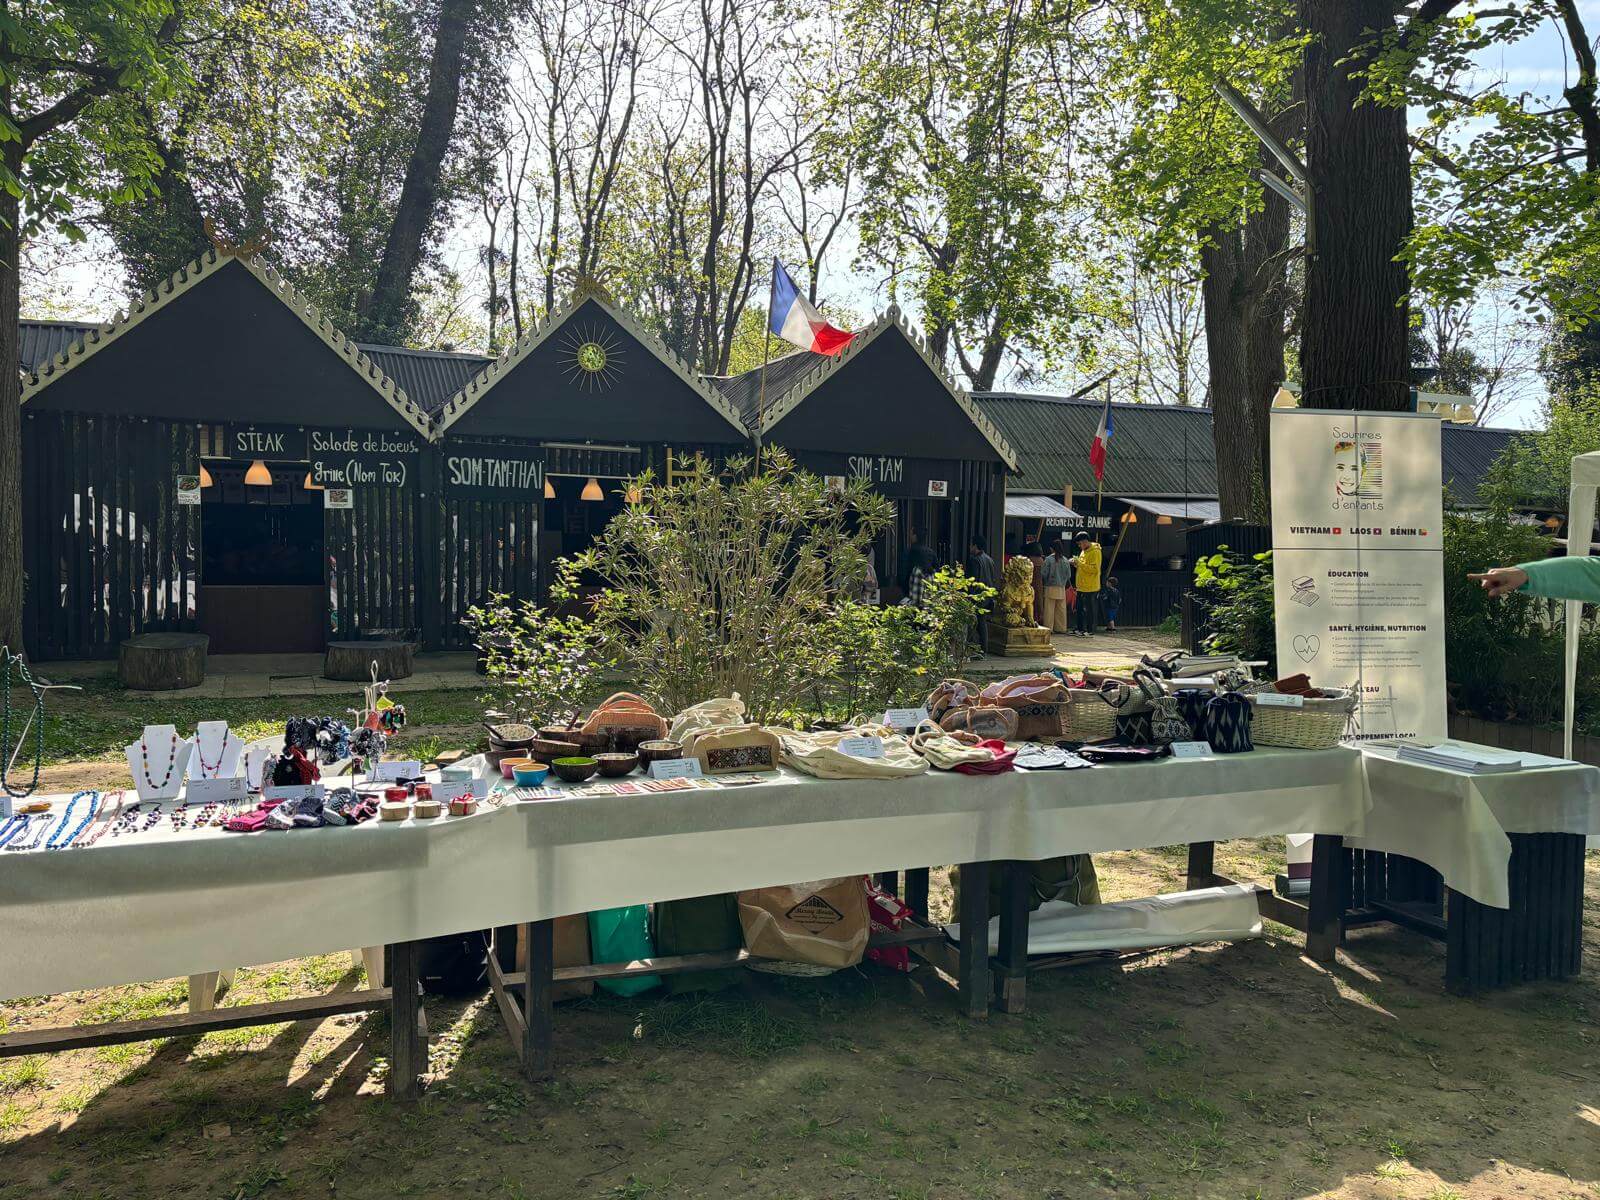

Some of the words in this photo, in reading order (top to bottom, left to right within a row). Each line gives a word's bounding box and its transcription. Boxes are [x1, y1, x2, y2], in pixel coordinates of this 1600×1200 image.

[1332, 427, 1382, 440] Sourires
[236, 432, 285, 452] STEAK
[848, 456, 903, 483] SOM-TAM
[1332, 497, 1384, 511] d'enfants
[1045, 516, 1074, 528] BEIGNETS
[1075, 516, 1085, 528] DE
[1290, 526, 1331, 535] VIETNAM
[1350, 527, 1372, 535] LAOS
[1390, 526, 1417, 536] BÉNIN
[1327, 569, 1369, 578] ÉDUCATION
[1328, 624, 1354, 632] SANTÉ,
[1355, 624, 1387, 632] HYGIÈNE,
